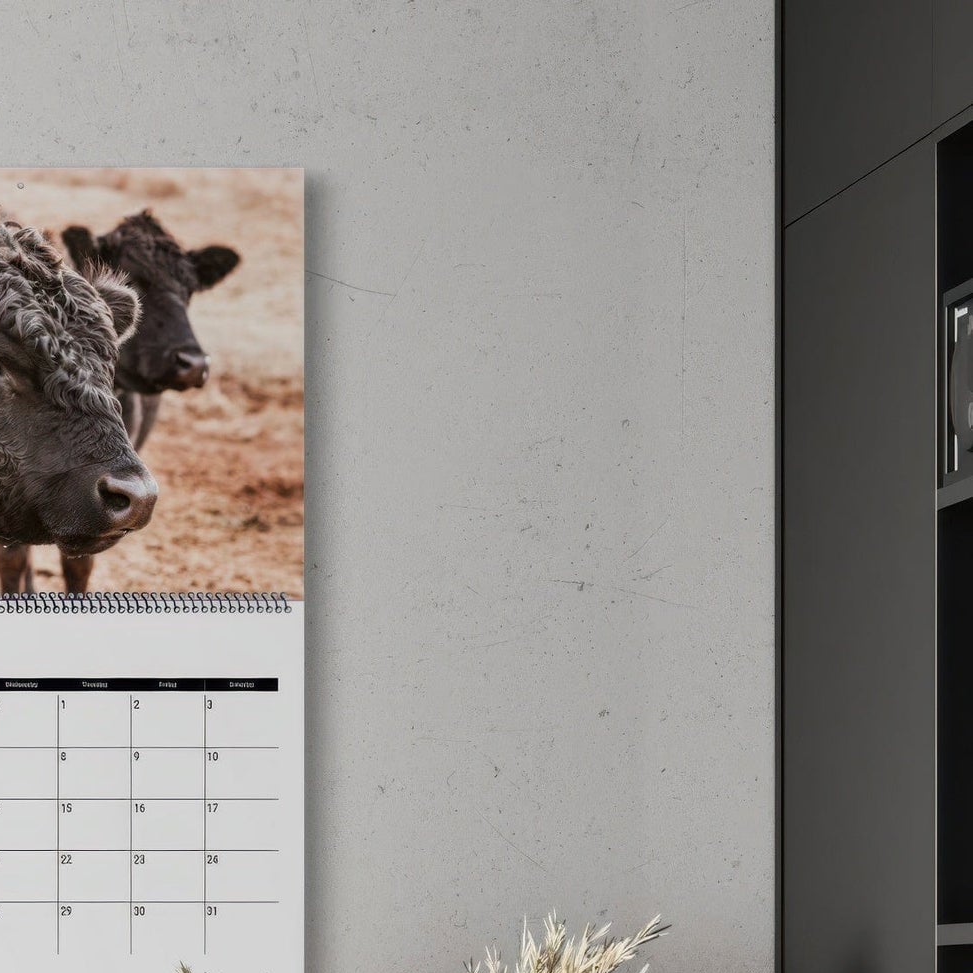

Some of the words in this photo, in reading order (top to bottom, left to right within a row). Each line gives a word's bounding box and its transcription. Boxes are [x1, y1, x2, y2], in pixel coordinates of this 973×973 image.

[61, 699, 66, 710] 1
[133, 699, 140, 710] 2
[207, 699, 213, 710] 3
[61, 751, 67, 762] 8
[133, 750, 140, 762] 9
[208, 751, 219, 762] 10
[62, 802, 73, 814] 15
[135, 802, 146, 814] 16
[207, 802, 219, 813] 17
[61, 854, 73, 865] 22
[61, 905, 73, 917] 29
[134, 905, 146, 917] 30
[207, 905, 217, 917] 31
